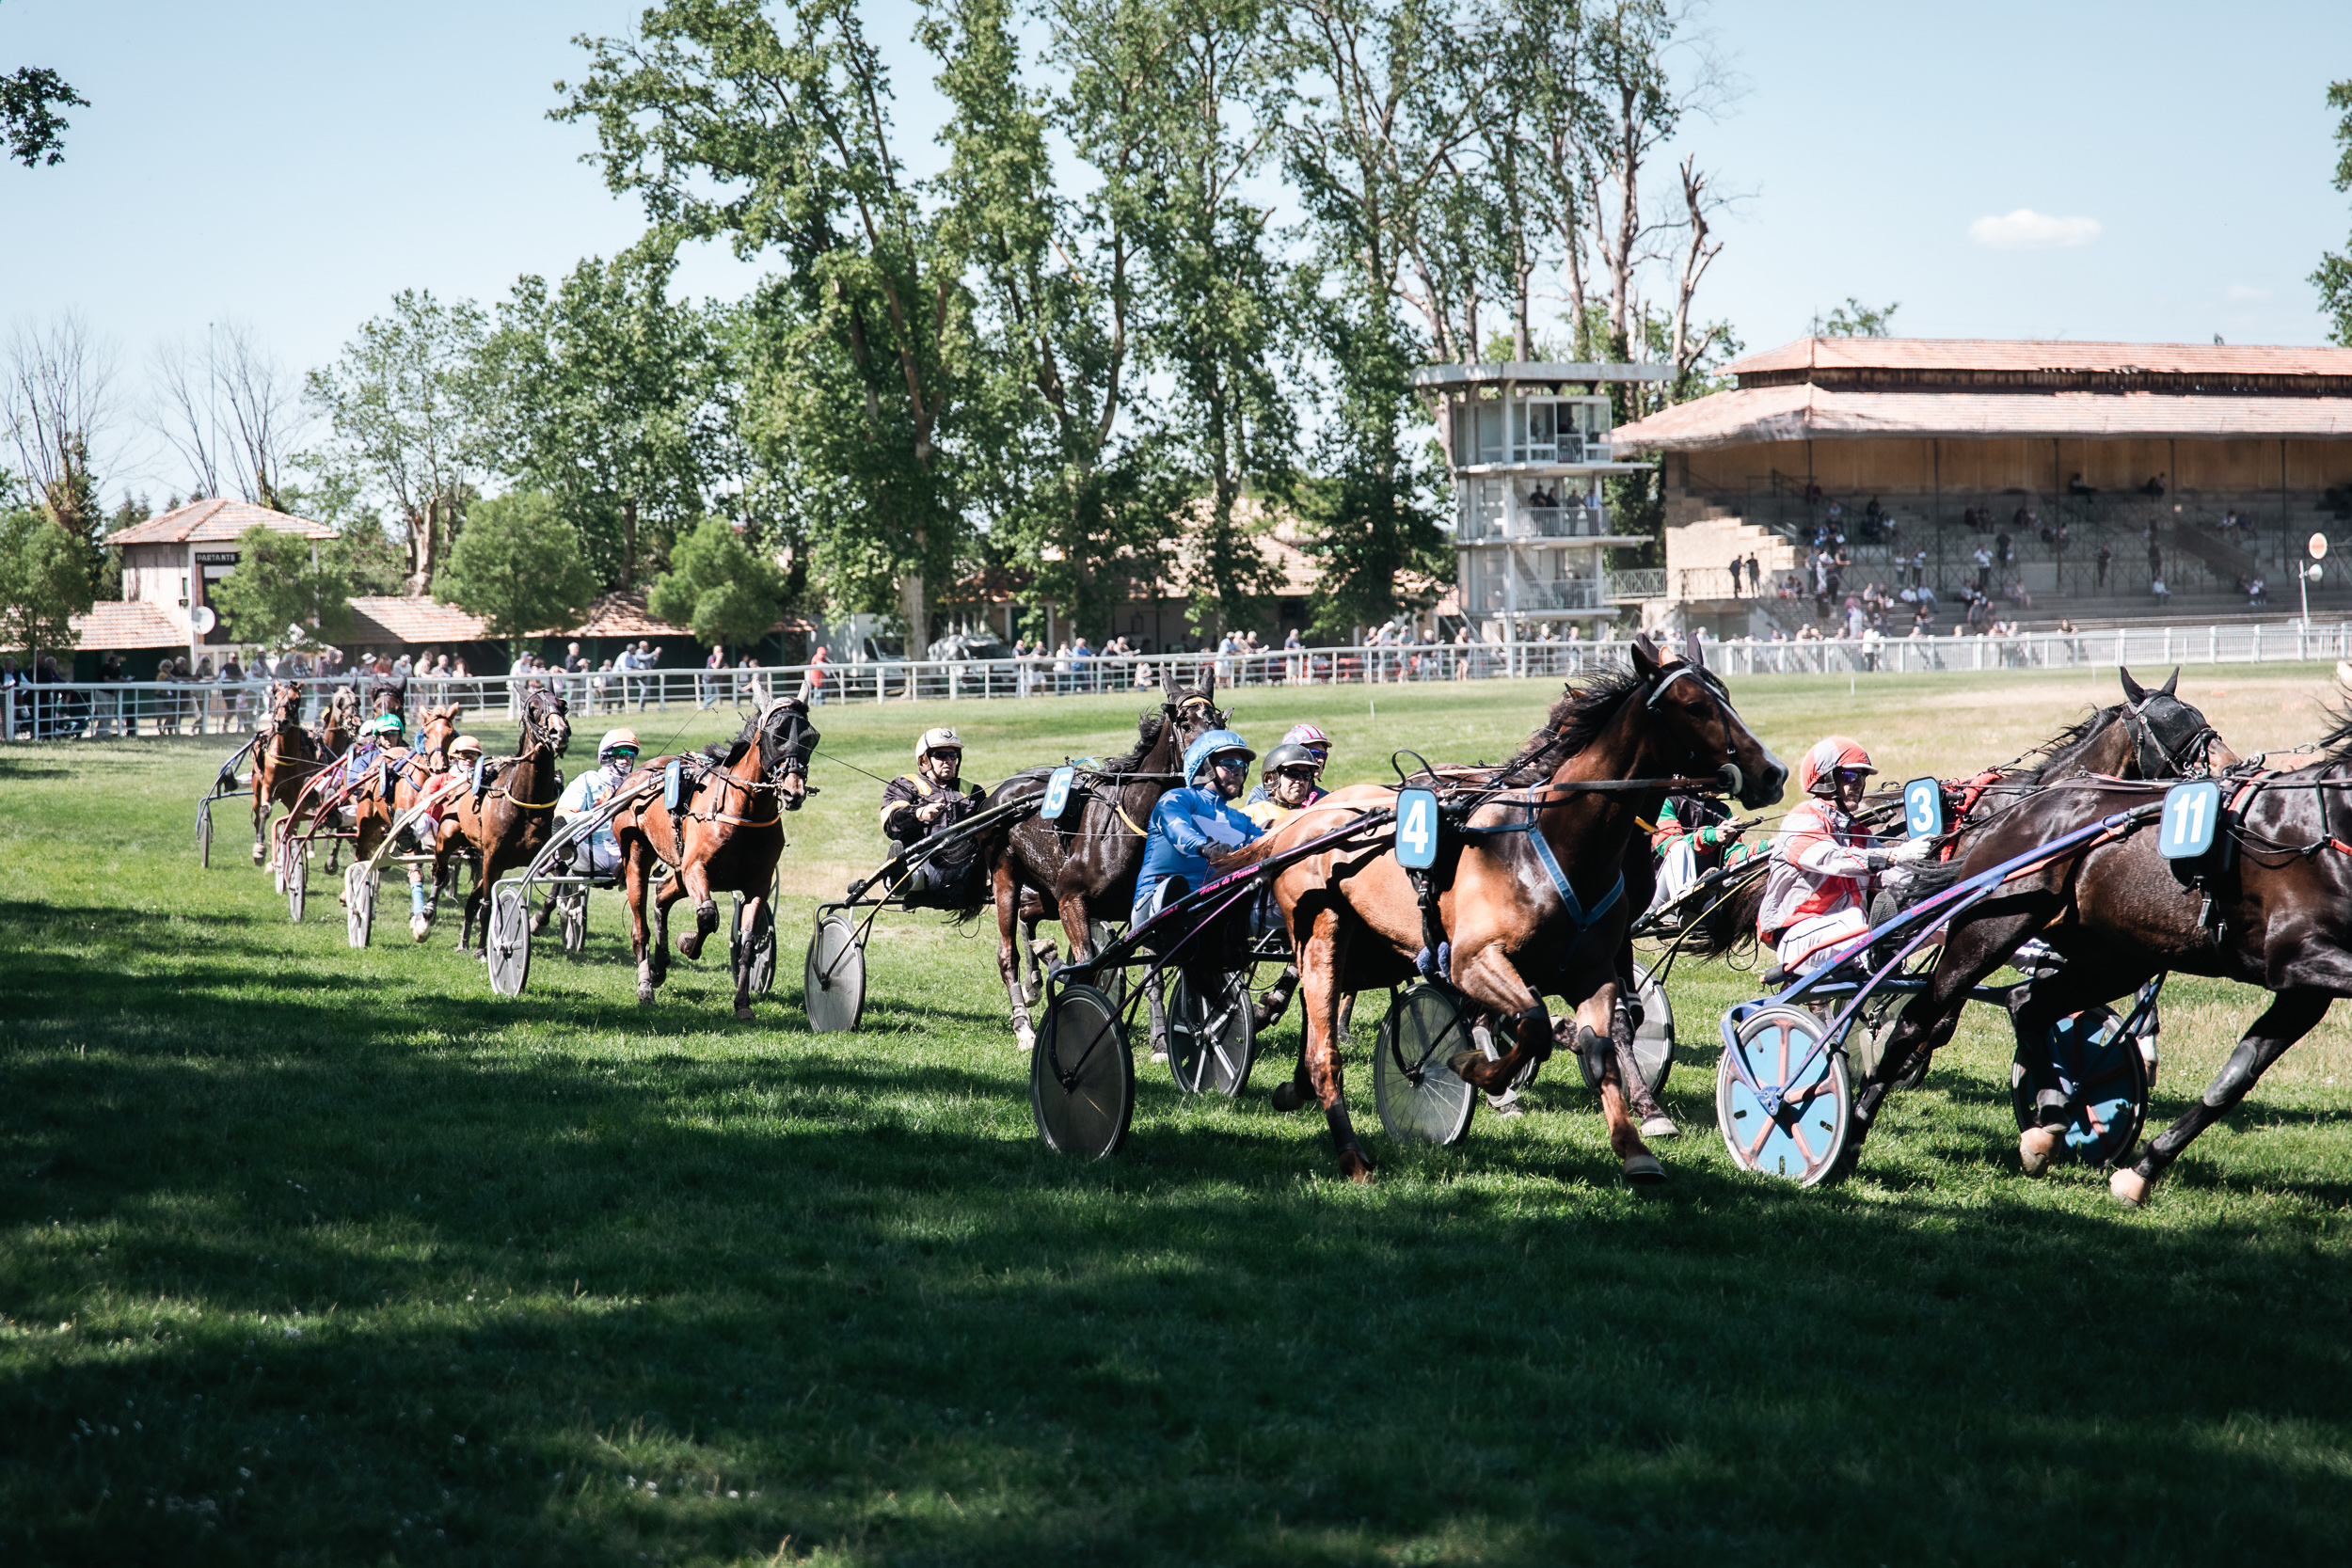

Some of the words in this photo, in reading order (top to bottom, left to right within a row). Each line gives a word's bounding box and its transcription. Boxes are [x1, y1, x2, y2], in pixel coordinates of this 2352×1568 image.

[667, 767, 677, 800] 7
[1044, 773, 1072, 811] 15
[1402, 800, 1428, 853] 4
[1911, 786, 1933, 832] 3
[2173, 791, 2207, 845] 11
[1221, 876, 1231, 886] de
